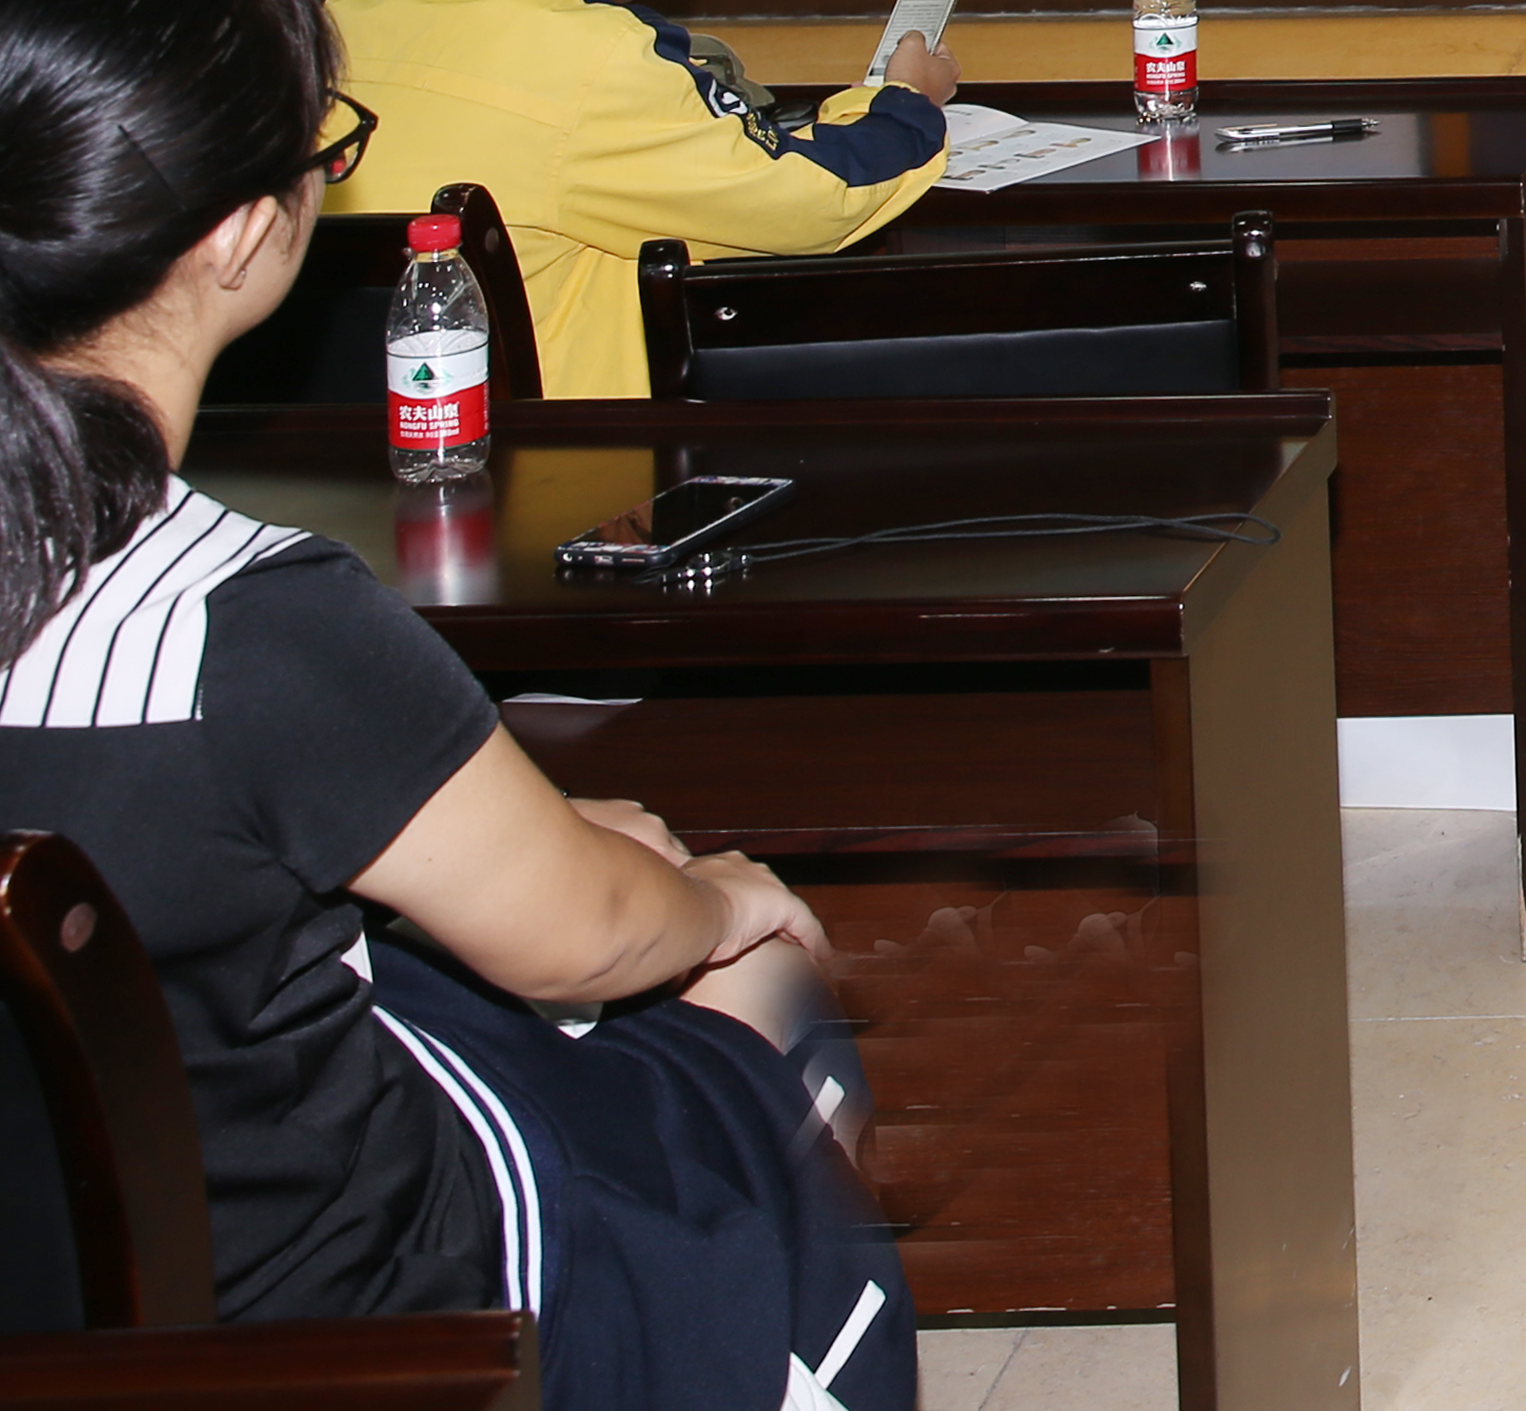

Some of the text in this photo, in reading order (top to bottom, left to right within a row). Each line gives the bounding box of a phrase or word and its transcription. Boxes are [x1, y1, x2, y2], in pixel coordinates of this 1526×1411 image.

[1146, 61, 1186, 73] 农夫山泉
[399, 402, 460, 421] 农夫山泉
